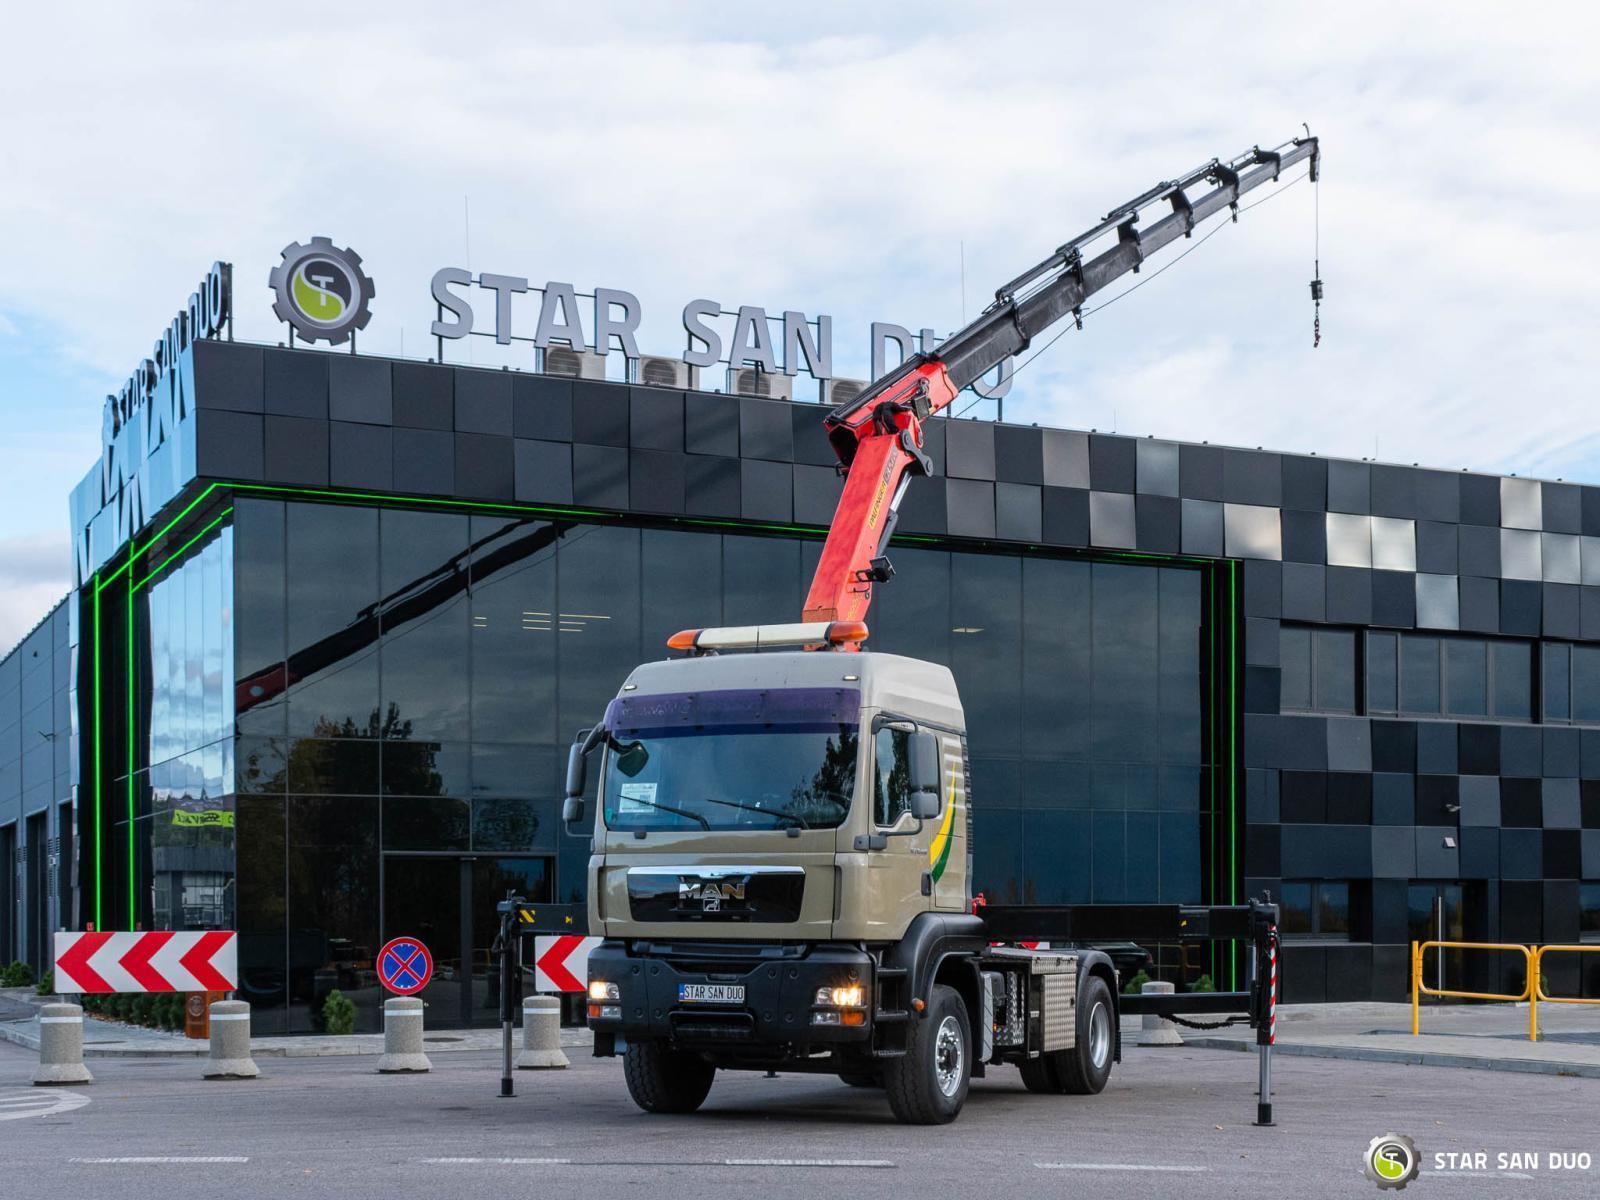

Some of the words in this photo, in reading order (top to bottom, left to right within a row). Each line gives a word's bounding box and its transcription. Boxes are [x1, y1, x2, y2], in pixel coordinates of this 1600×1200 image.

[188, 260, 228, 343] DUO
[430, 267, 641, 359] STAR
[682, 298, 833, 380] SAN
[679, 883, 745, 900] MAN
[684, 985, 705, 999] STAR
[708, 986, 724, 999] SAN
[727, 987, 744, 1000] DUO
